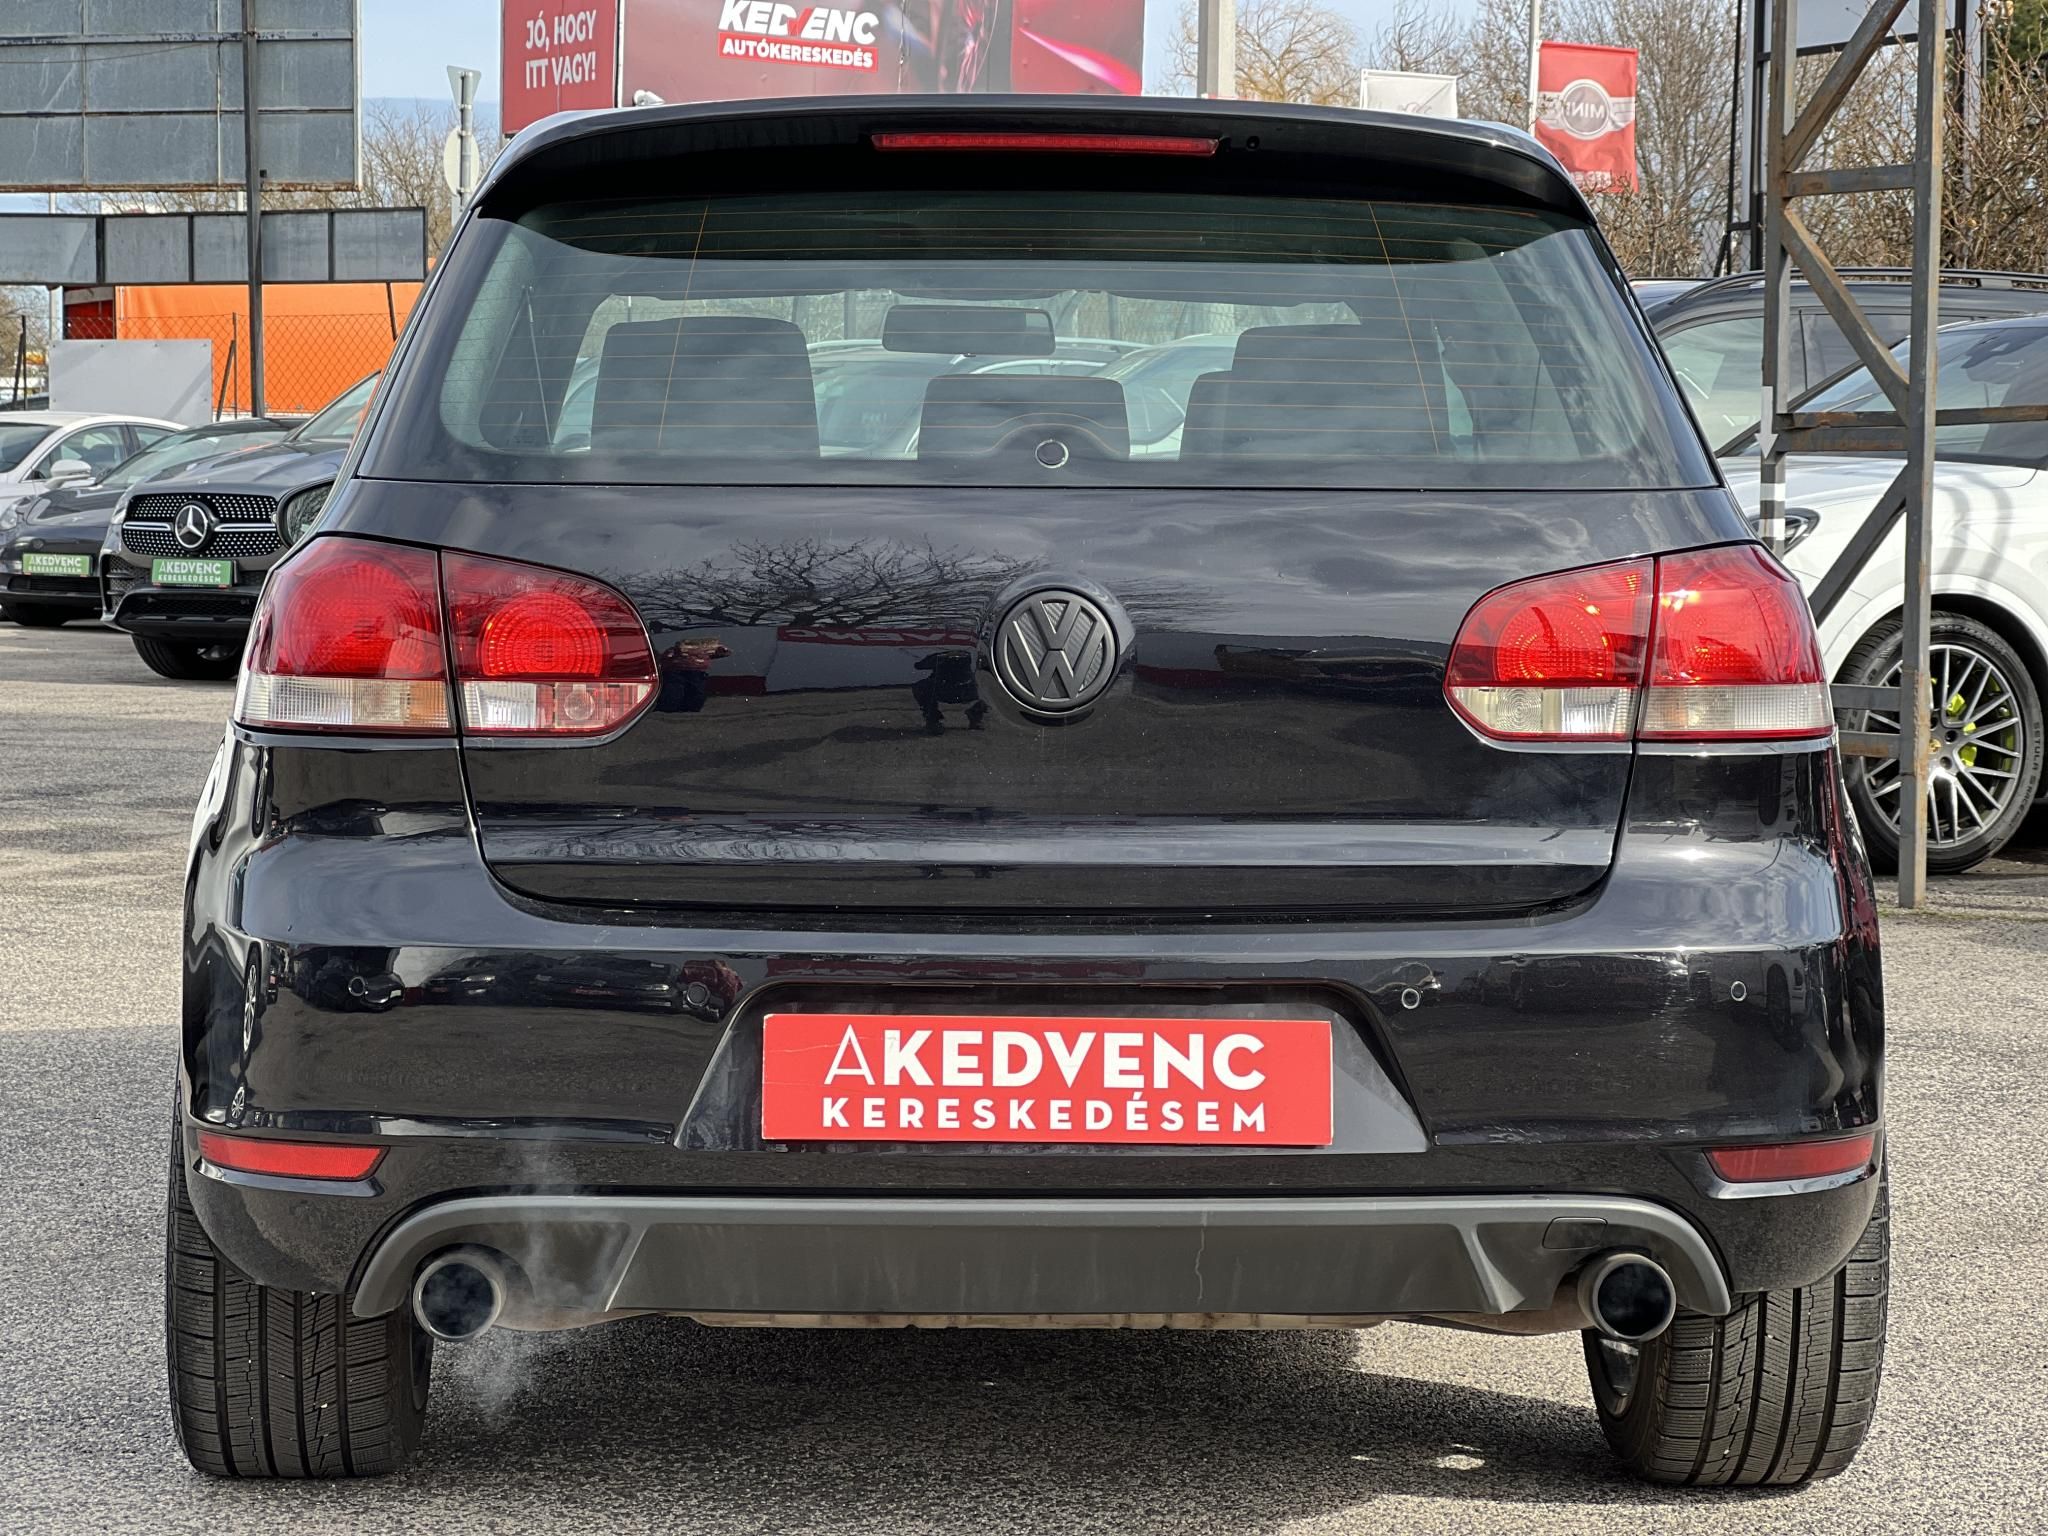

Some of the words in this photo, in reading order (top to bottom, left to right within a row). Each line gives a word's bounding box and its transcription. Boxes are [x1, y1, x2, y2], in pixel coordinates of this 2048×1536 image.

[525, 10, 549, 52] JÓ,
[553, 9, 597, 45] HOGY
[526, 58, 549, 89] ITT
[551, 50, 596, 86] VAGY!
[722, 38, 873, 68] AUTÓKERESKEDÉS
[822, 1091, 1266, 1133] KERESKEDÉSEM
